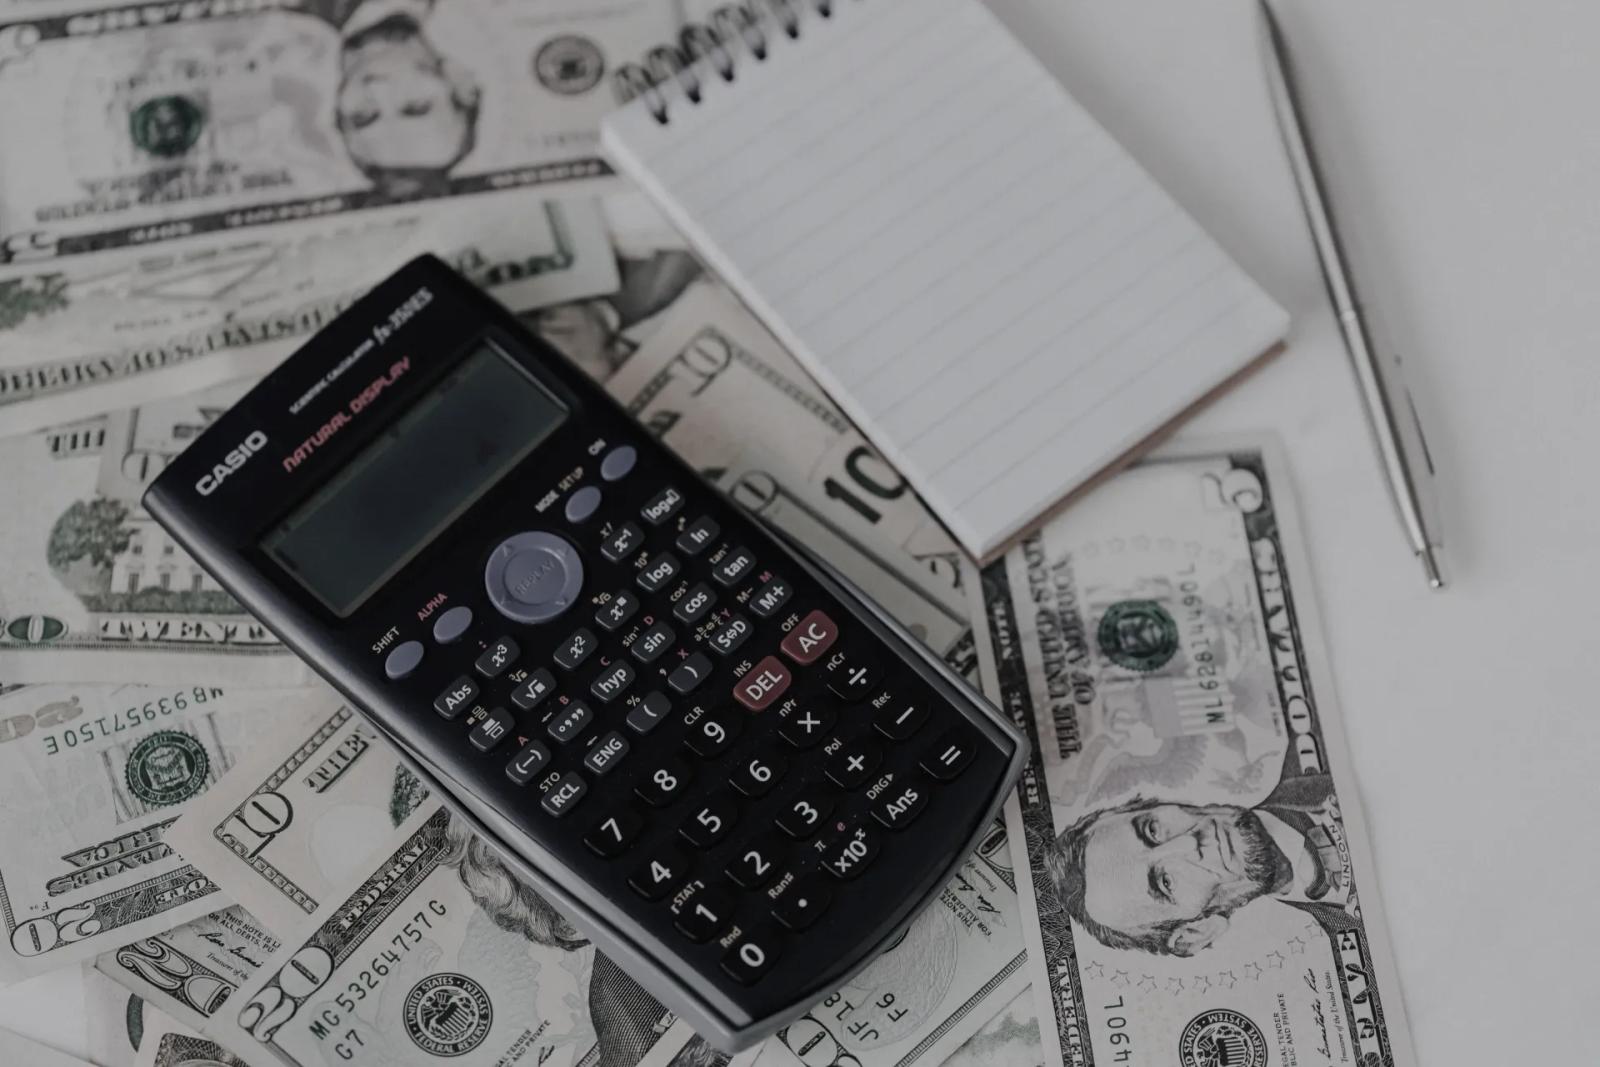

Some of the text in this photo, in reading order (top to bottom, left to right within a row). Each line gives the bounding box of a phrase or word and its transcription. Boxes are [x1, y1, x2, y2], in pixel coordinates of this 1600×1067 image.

[282, 355, 411, 473] NATURAL DISPLAY
[194, 430, 268, 496] CASIO
[646, 560, 674, 584] log
[723, 555, 749, 578] tan
[417, 592, 448, 621] ALPHA
[684, 591, 709, 614] cos
[781, 613, 800, 632] OFF
[371, 626, 400, 654] SHIFT
[643, 631, 666, 653] sin
[798, 623, 828, 654] AC
[732, 659, 753, 678] INS
[826, 650, 846, 672] nCr
[598, 667, 627, 694] hyp
[745, 670, 784, 701] DEL
[444, 683, 473, 710] Abs
[778, 698, 798, 718] nPr
[871, 691, 891, 709] Rec
[683, 706, 705, 726] CLR
[703, 720, 727, 744] 9
[592, 737, 624, 768] ENG
[823, 737, 843, 756] Pol
[539, 771, 561, 792] STO
[653, 769, 677, 792] 8
[749, 759, 772, 783] 6
[550, 782, 580, 808] RCL
[885, 787, 919, 820] Ans
[696, 808, 722, 833] 5
[793, 801, 819, 825] 3
[600, 817, 624, 842] 7
[743, 850, 771, 876] 2
[1328, 823, 1352, 888] LINCOLN
[650, 860, 672, 884] 4
[338, 838, 429, 932] FEDERAL
[695, 903, 718, 924] 1
[719, 926, 742, 948] Rnd
[739, 943, 766, 967] 0
[408, 976, 454, 1025] UNITED STATES
[415, 981, 488, 1053] FEDERAL RESERVE SYSTEM
